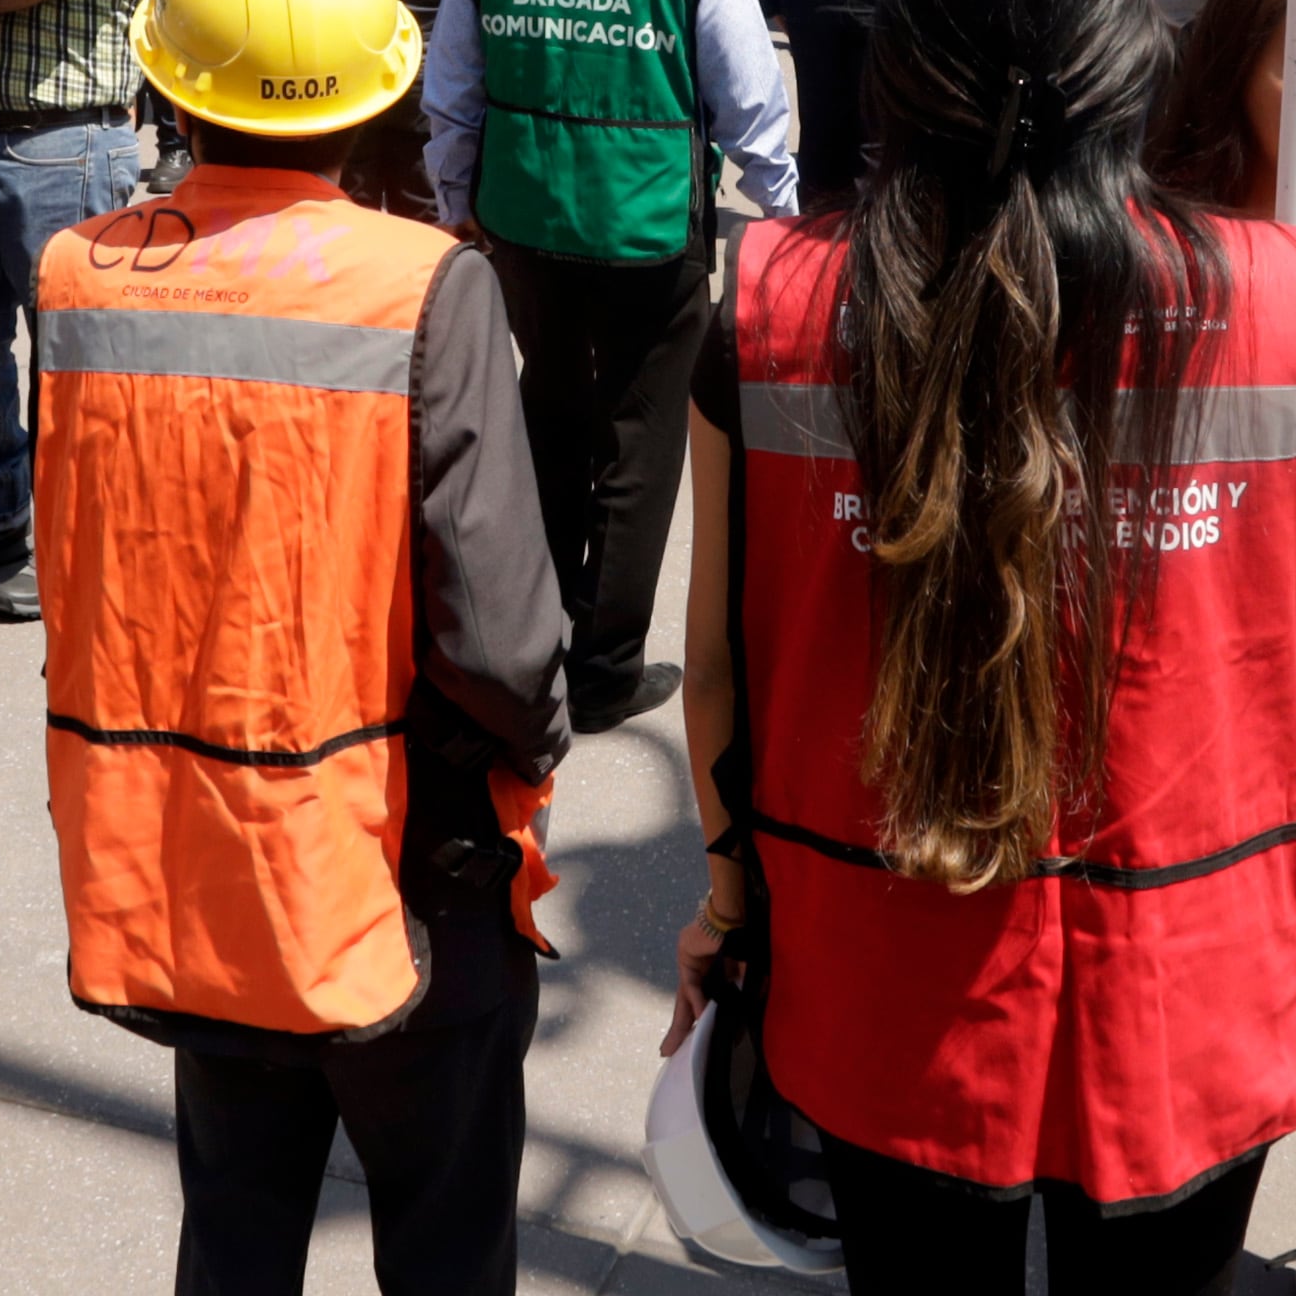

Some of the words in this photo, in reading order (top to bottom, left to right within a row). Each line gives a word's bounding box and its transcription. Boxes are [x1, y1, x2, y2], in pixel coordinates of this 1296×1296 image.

[481, 14, 676, 54] COMUNICACIÓN
[261, 75, 339, 100] D.G.O.P.
[88, 207, 353, 283] CDMX
[122, 284, 169, 299] CIUDAD
[173, 287, 191, 301] DE
[194, 287, 249, 305] MÉXICO
[1228, 482, 1247, 508] Y
